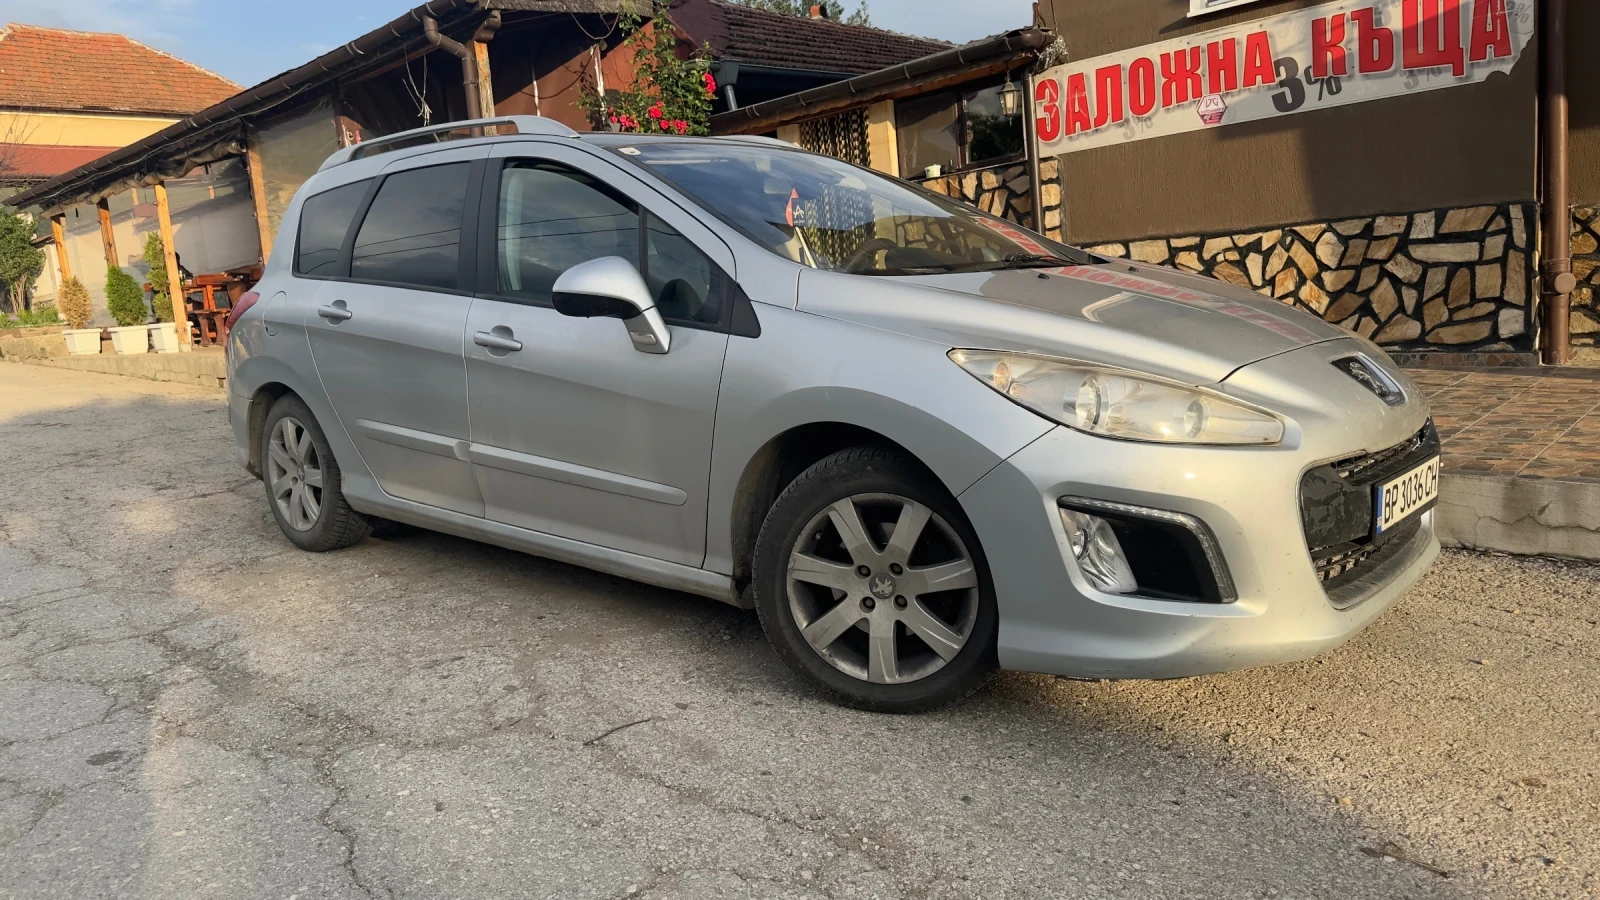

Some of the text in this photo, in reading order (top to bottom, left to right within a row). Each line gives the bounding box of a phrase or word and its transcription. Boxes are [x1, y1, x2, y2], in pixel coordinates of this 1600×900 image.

[1035, 0, 1513, 142] ЗАЛОЖНА КЪЩА
[1384, 461, 1438, 525] BP 3036 CH
